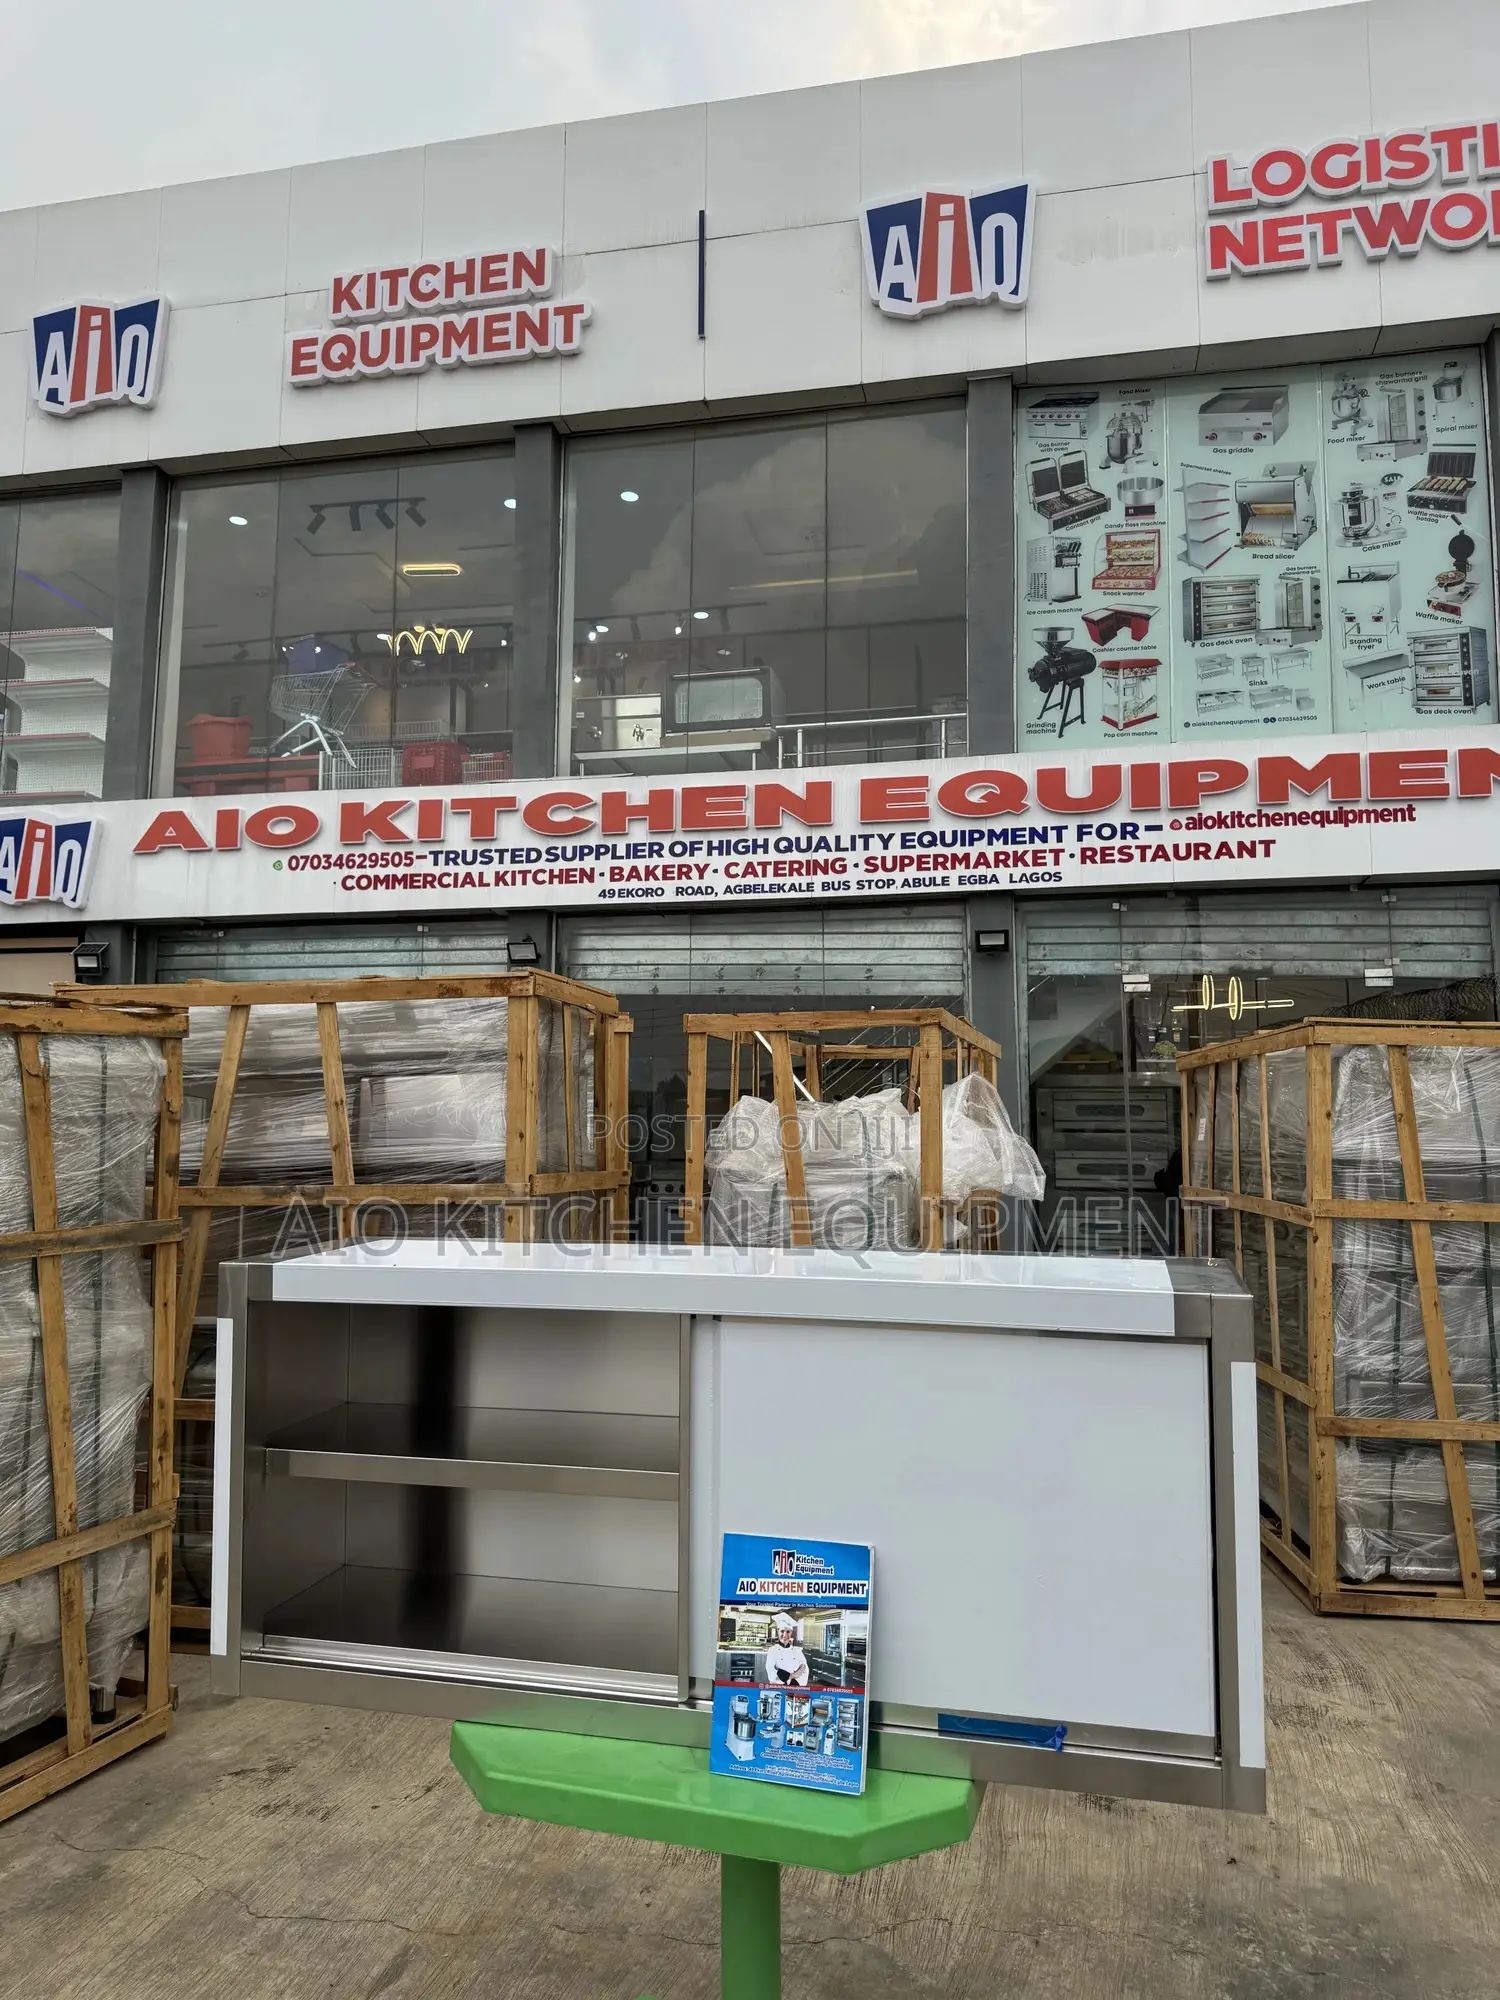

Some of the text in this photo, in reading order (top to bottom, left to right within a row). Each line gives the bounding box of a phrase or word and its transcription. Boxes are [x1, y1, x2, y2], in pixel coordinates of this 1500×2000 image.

[1212, 122, 1500, 203] LOGISTI
[331, 246, 547, 316] KITCHEN
[290, 303, 585, 377] EQUIPMENT
[1395, 370, 1423, 378] burners
[1375, 375, 1428, 386] shawarma grill
[1135, 387, 1151, 395] Mixer
[1458, 423, 1478, 431] mixer
[1347, 435, 1366, 443] mixer
[1228, 446, 1254, 455] griddle
[1180, 462, 1212, 473] Supermarket
[1407, 509, 1449, 520] Waffle maker
[1416, 516, 1439, 524] hotdog
[1066, 515, 1102, 531] Contact grill
[1104, 522, 1124, 530] Candy
[1362, 540, 1402, 552] Cake mixer
[1415, 611, 1464, 625] Waffle maker
[1199, 640, 1214, 648] Gas
[1215, 638, 1234, 646] deck
[1349, 637, 1383, 645] Standing
[1357, 643, 1375, 651] fryer
[1367, 676, 1406, 690] Work table
[1026, 721, 1057, 730] Grinding
[133, 804, 321, 854] AIO
[339, 780, 834, 844] KITCHEN
[545, 841, 664, 864] SUPPLIER
[668, 839, 704, 858] OF
[706, 837, 770, 857] HIGH
[773, 832, 896, 855] QUALITY
[899, 824, 1069, 850] EQUIPMENT
[1184, 804, 1417, 832] aiokitchenequipment
[341, 839, 1276, 892] COMMERCIAL KITCHEN BAKERY CATERING SUPERMARKET RESTAURANT
[675, 885, 718, 898] ROAD,
[723, 882, 815, 896] AGBELEKALE
[821, 880, 851, 892] BUS
[900, 876, 950, 889] ABULE
[957, 874, 1000, 886] EGBA
[1009, 871, 1063, 884] LAGOS
[796, 1555, 824, 1565] Kitchen
[796, 1564, 834, 1576] Equipment
[738, 1580, 867, 1596] AIO KITCHEN EQUIPMENT
